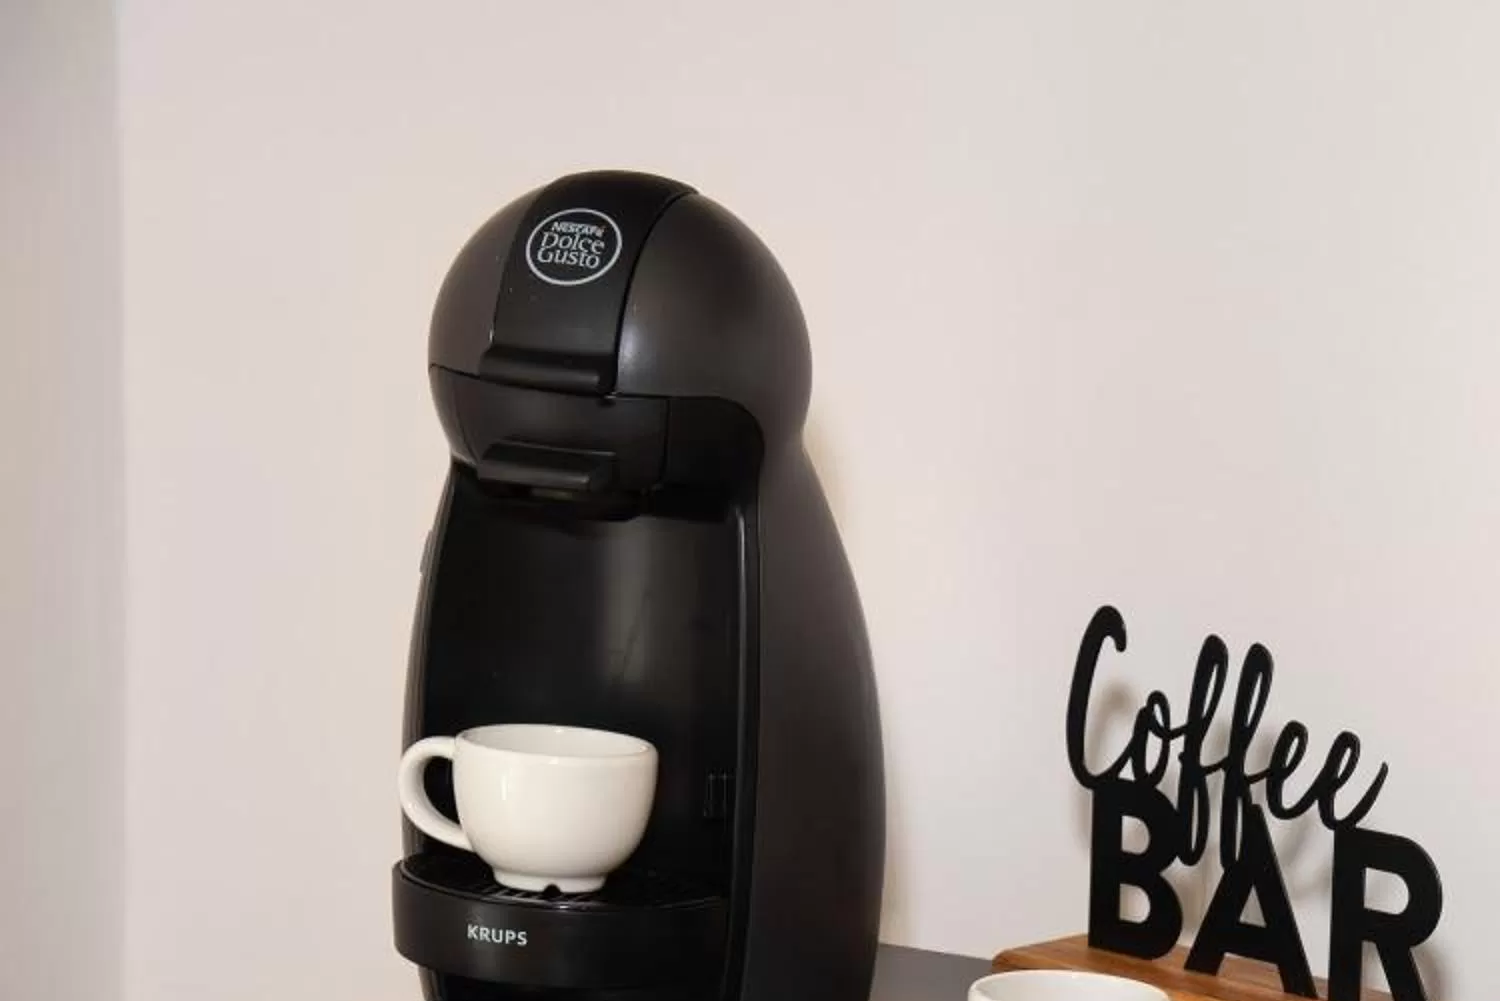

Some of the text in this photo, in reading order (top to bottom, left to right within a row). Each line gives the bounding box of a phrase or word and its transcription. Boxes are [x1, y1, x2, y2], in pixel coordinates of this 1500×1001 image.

[541, 231, 605, 254] Dolce
[1066, 605, 1389, 867] Coffee
[467, 924, 528, 947] KRUPS
